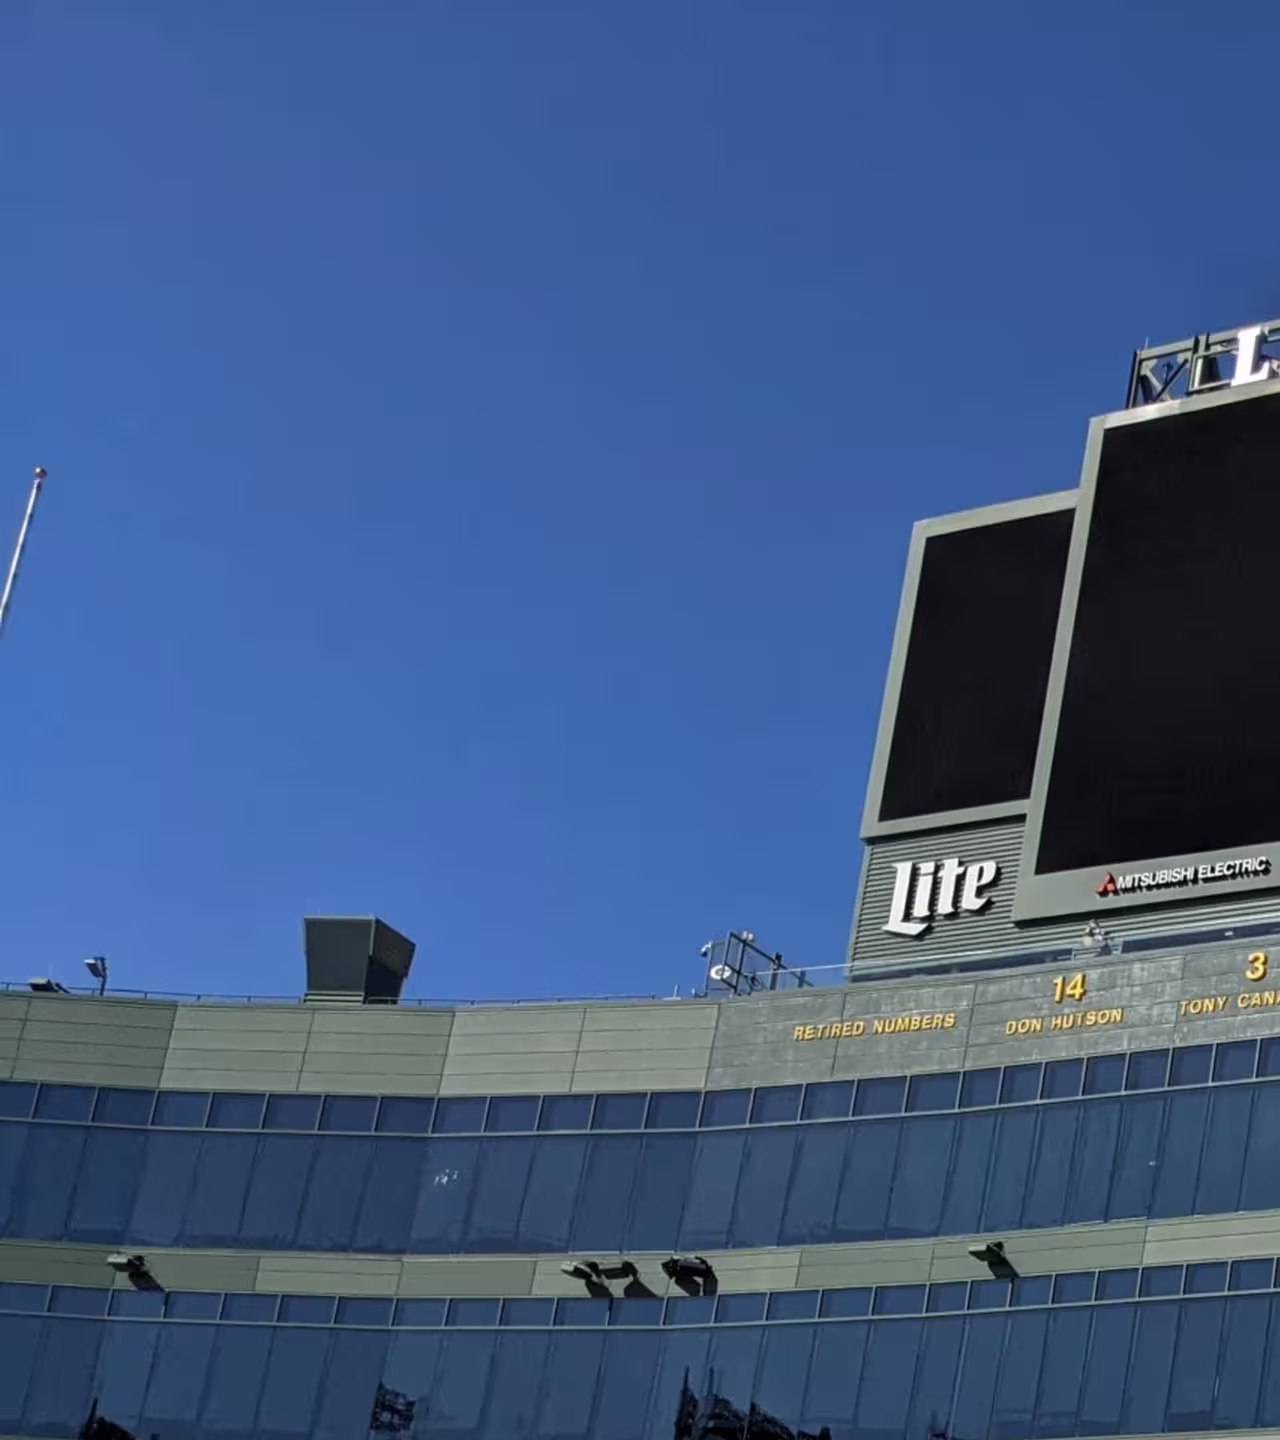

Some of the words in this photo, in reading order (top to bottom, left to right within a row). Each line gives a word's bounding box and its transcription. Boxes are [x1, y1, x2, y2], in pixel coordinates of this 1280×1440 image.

[1117, 866, 1195, 889] MITSUBISHI
[1197, 856, 1270, 879] ELECTRIC
[882, 857, 998, 936] Lite
[1245, 952, 1267, 981] 3
[1052, 972, 1087, 1004] 14
[1179, 995, 1230, 1016] TONY
[793, 1019, 866, 1041] RETIRED
[873, 1011, 957, 1035] NUMBERS
[1005, 1018, 1043, 1036] DON
[1051, 1008, 1125, 1031] HUTSON
